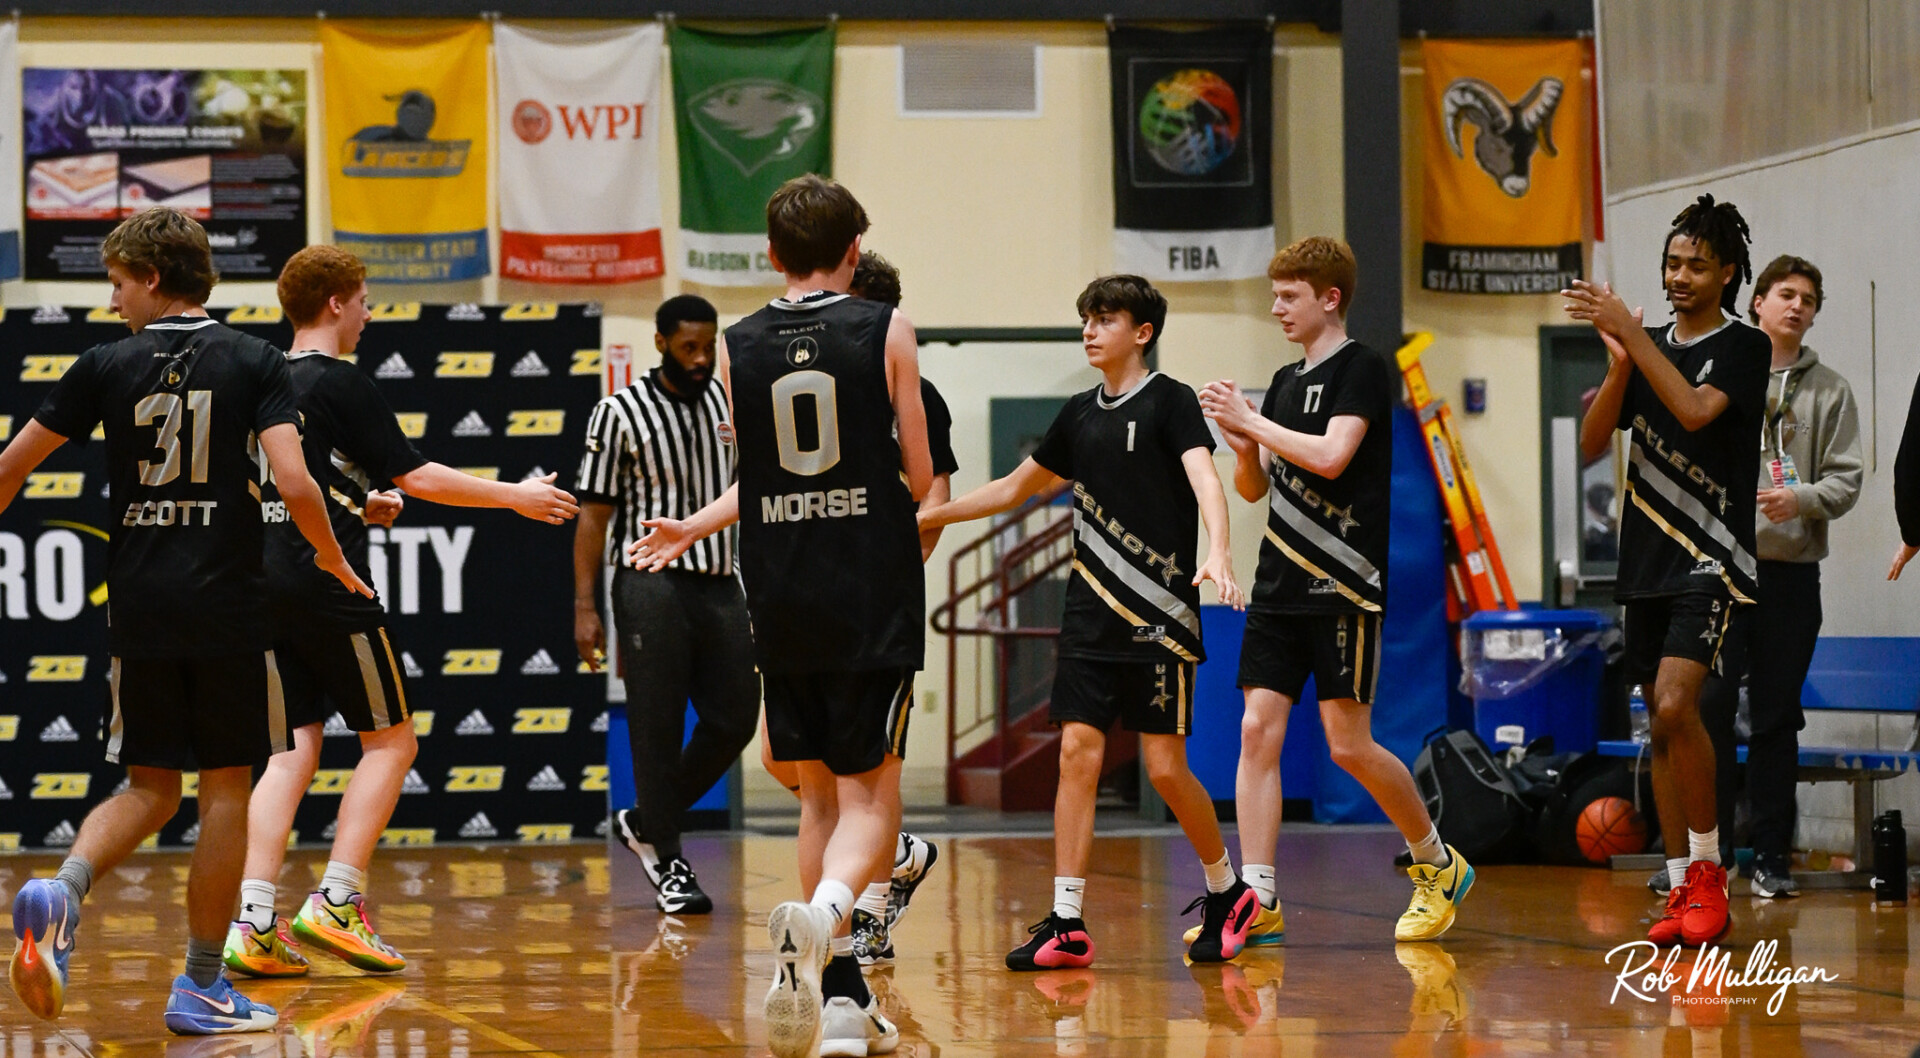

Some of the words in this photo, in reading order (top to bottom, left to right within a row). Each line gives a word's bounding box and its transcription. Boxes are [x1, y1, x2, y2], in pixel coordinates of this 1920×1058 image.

[558, 104, 645, 139] WPI
[1169, 246, 1220, 270] FIBA
[1449, 250, 1559, 271] FRAMINGHAM
[1426, 269, 1480, 291] STATE
[434, 352, 496, 378] ZG
[505, 410, 566, 437] ZG
[771, 370, 841, 476] 0
[1127, 421, 1136, 451] 1
[134, 390, 212, 486] 31
[24, 472, 85, 499] ZG
[123, 501, 217, 527] SCOTT
[761, 488, 868, 523] MORSE
[1073, 481, 1172, 567] SELECT
[26, 655, 88, 682] ZG
[441, 649, 502, 675] ZG
[511, 707, 572, 734] ZG
[30, 772, 92, 799] ZG
[444, 765, 506, 792] ZG
